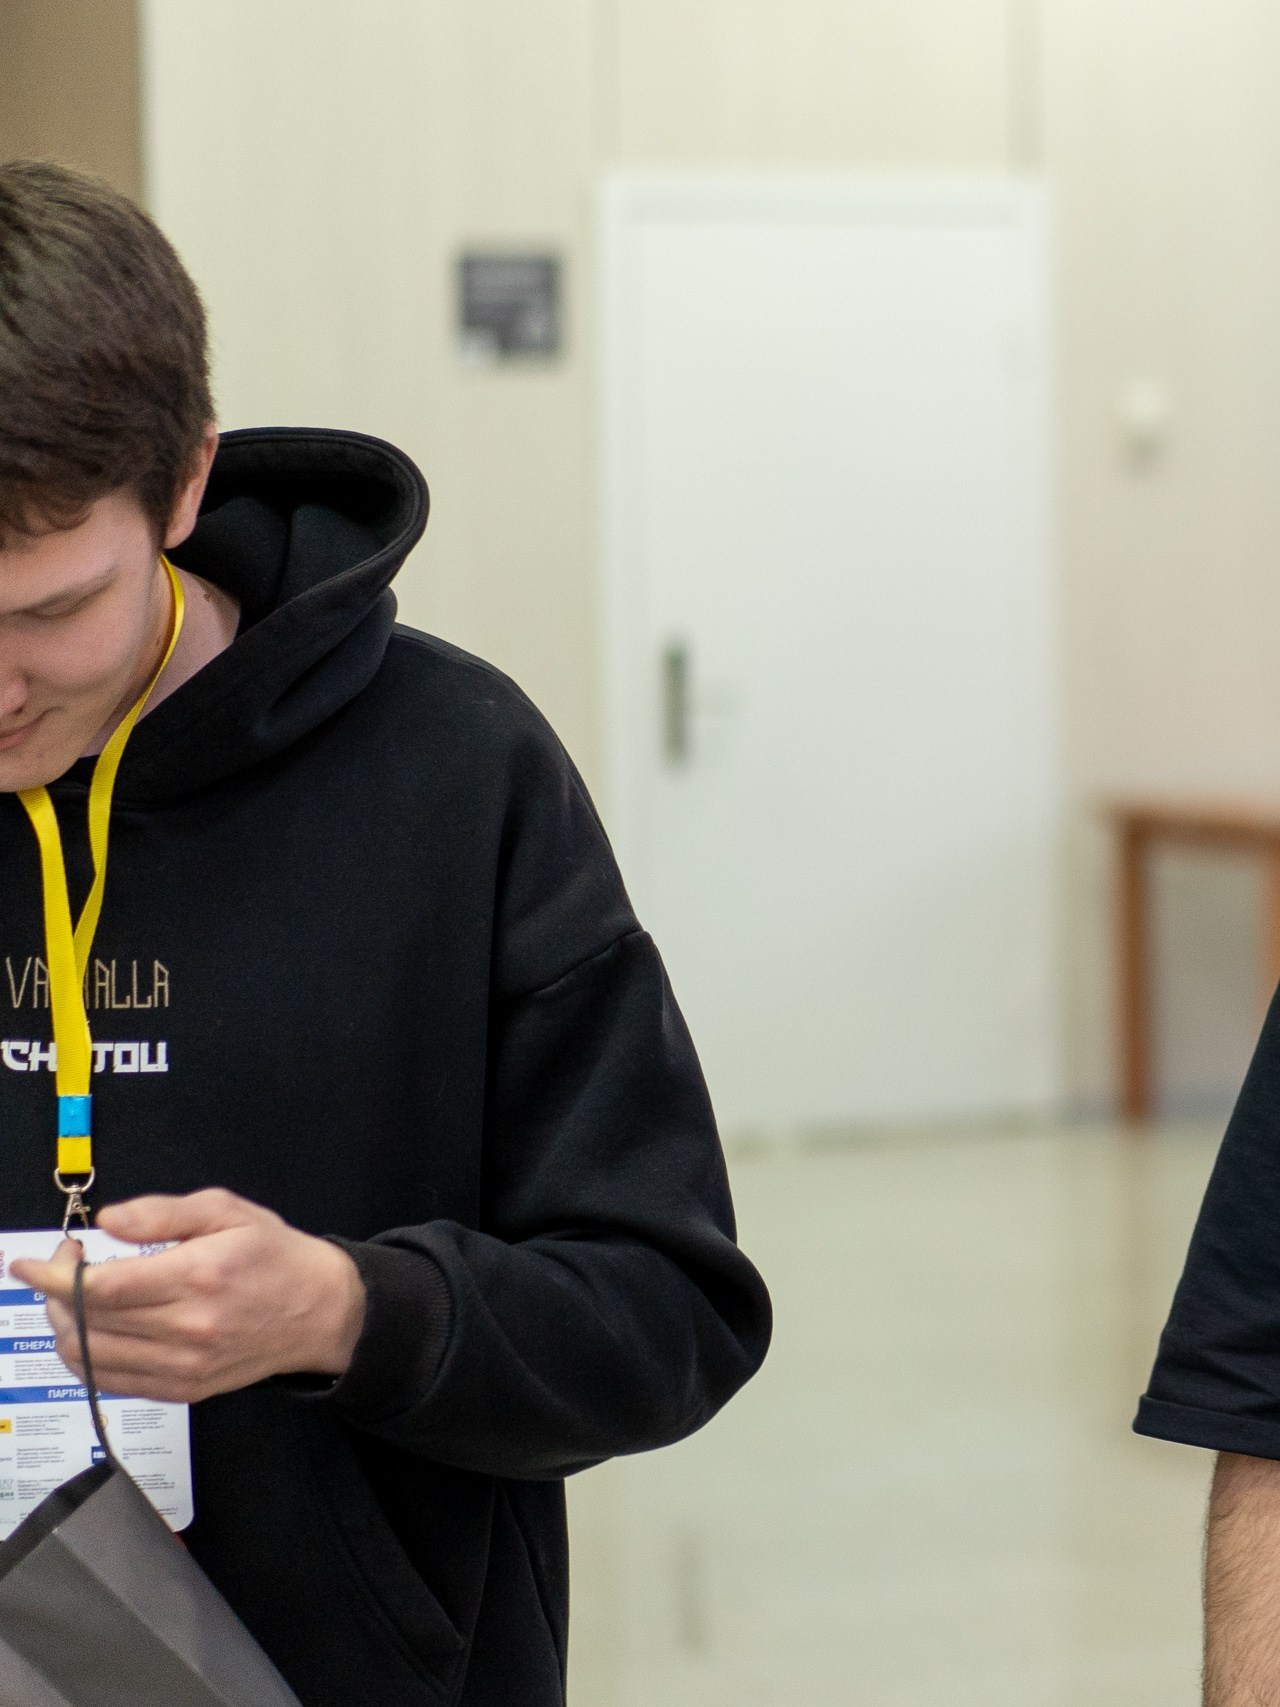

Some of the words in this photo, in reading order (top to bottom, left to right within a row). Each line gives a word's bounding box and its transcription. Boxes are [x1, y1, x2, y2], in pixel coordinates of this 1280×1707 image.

[5, 956, 170, 1009] VAALLA
[1, 1040, 169, 1073] CHTOU
[13, 1341, 56, 1351] ГЕНЕРА
[48, 1388, 90, 1399] ПАРТНЕ
